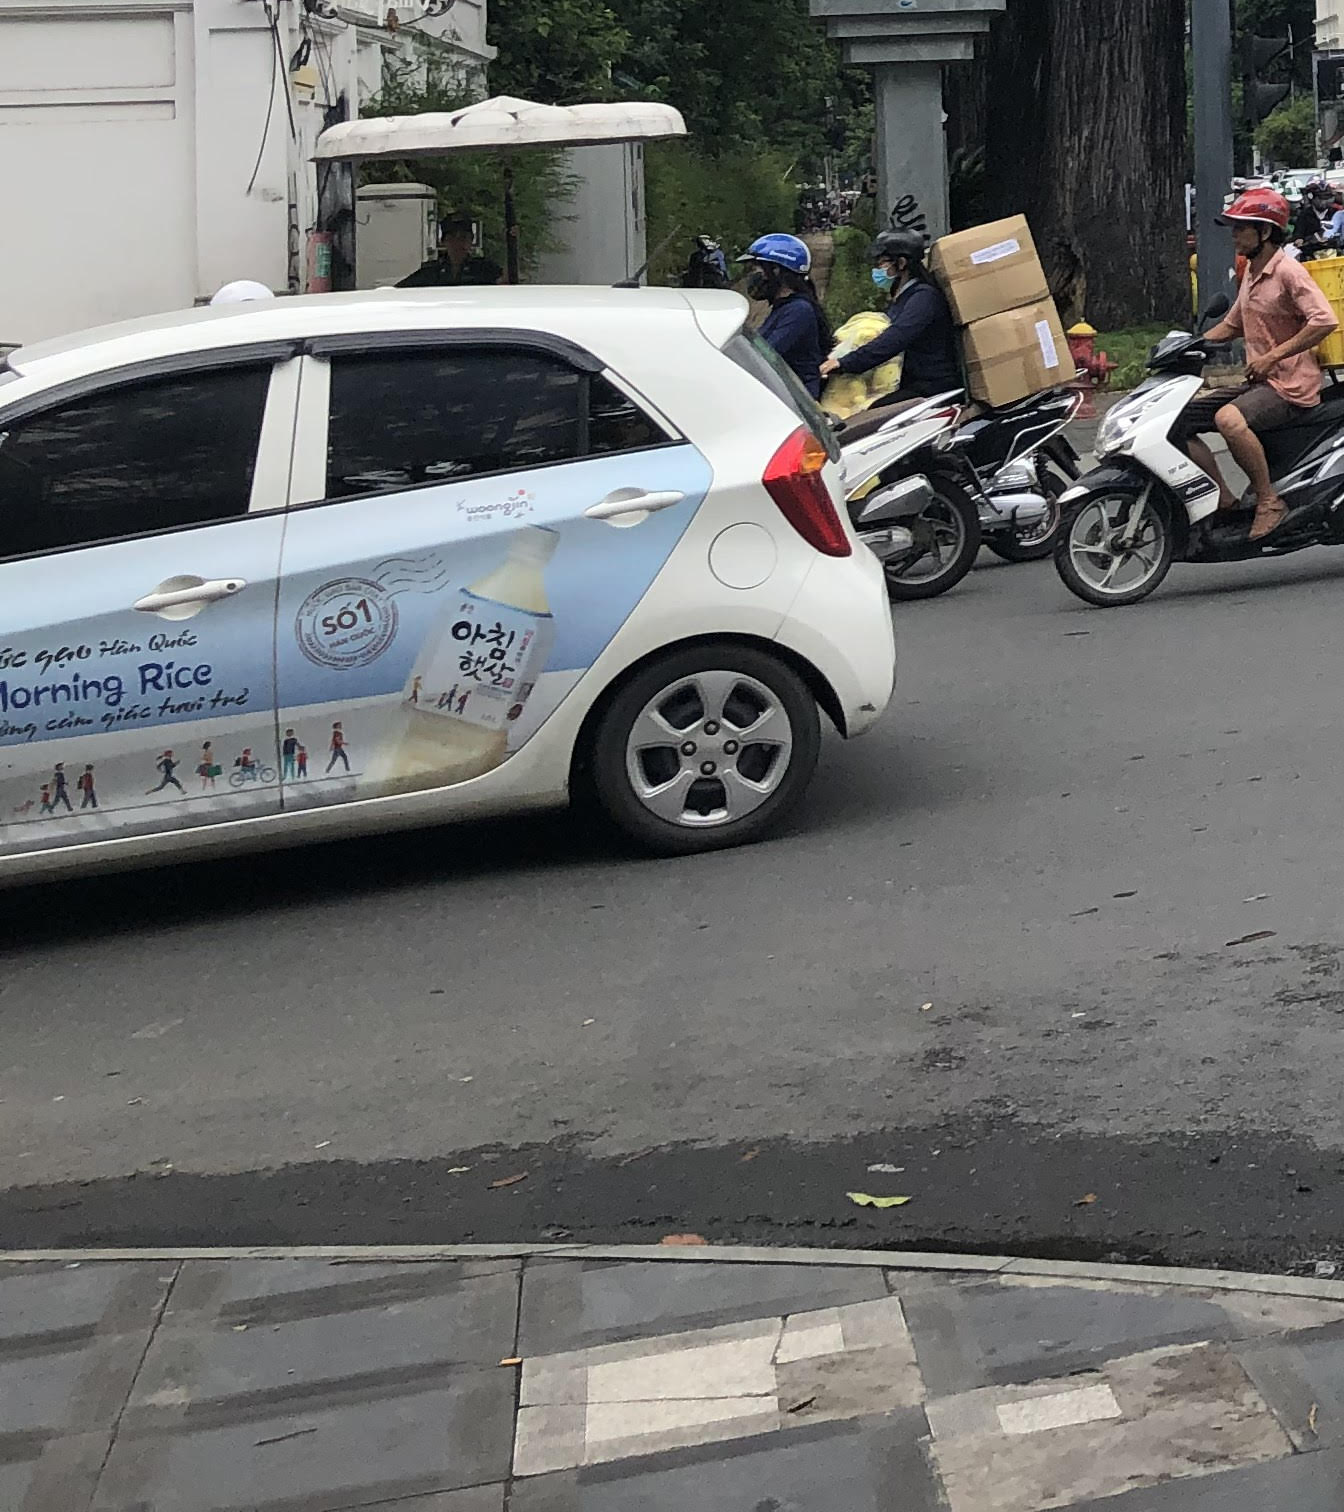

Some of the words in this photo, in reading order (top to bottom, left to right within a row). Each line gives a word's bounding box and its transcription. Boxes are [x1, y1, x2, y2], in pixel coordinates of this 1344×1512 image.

[466, 496, 529, 516] woongjin
[451, 621, 515, 660] 아침
[138, 661, 212, 695] Rice
